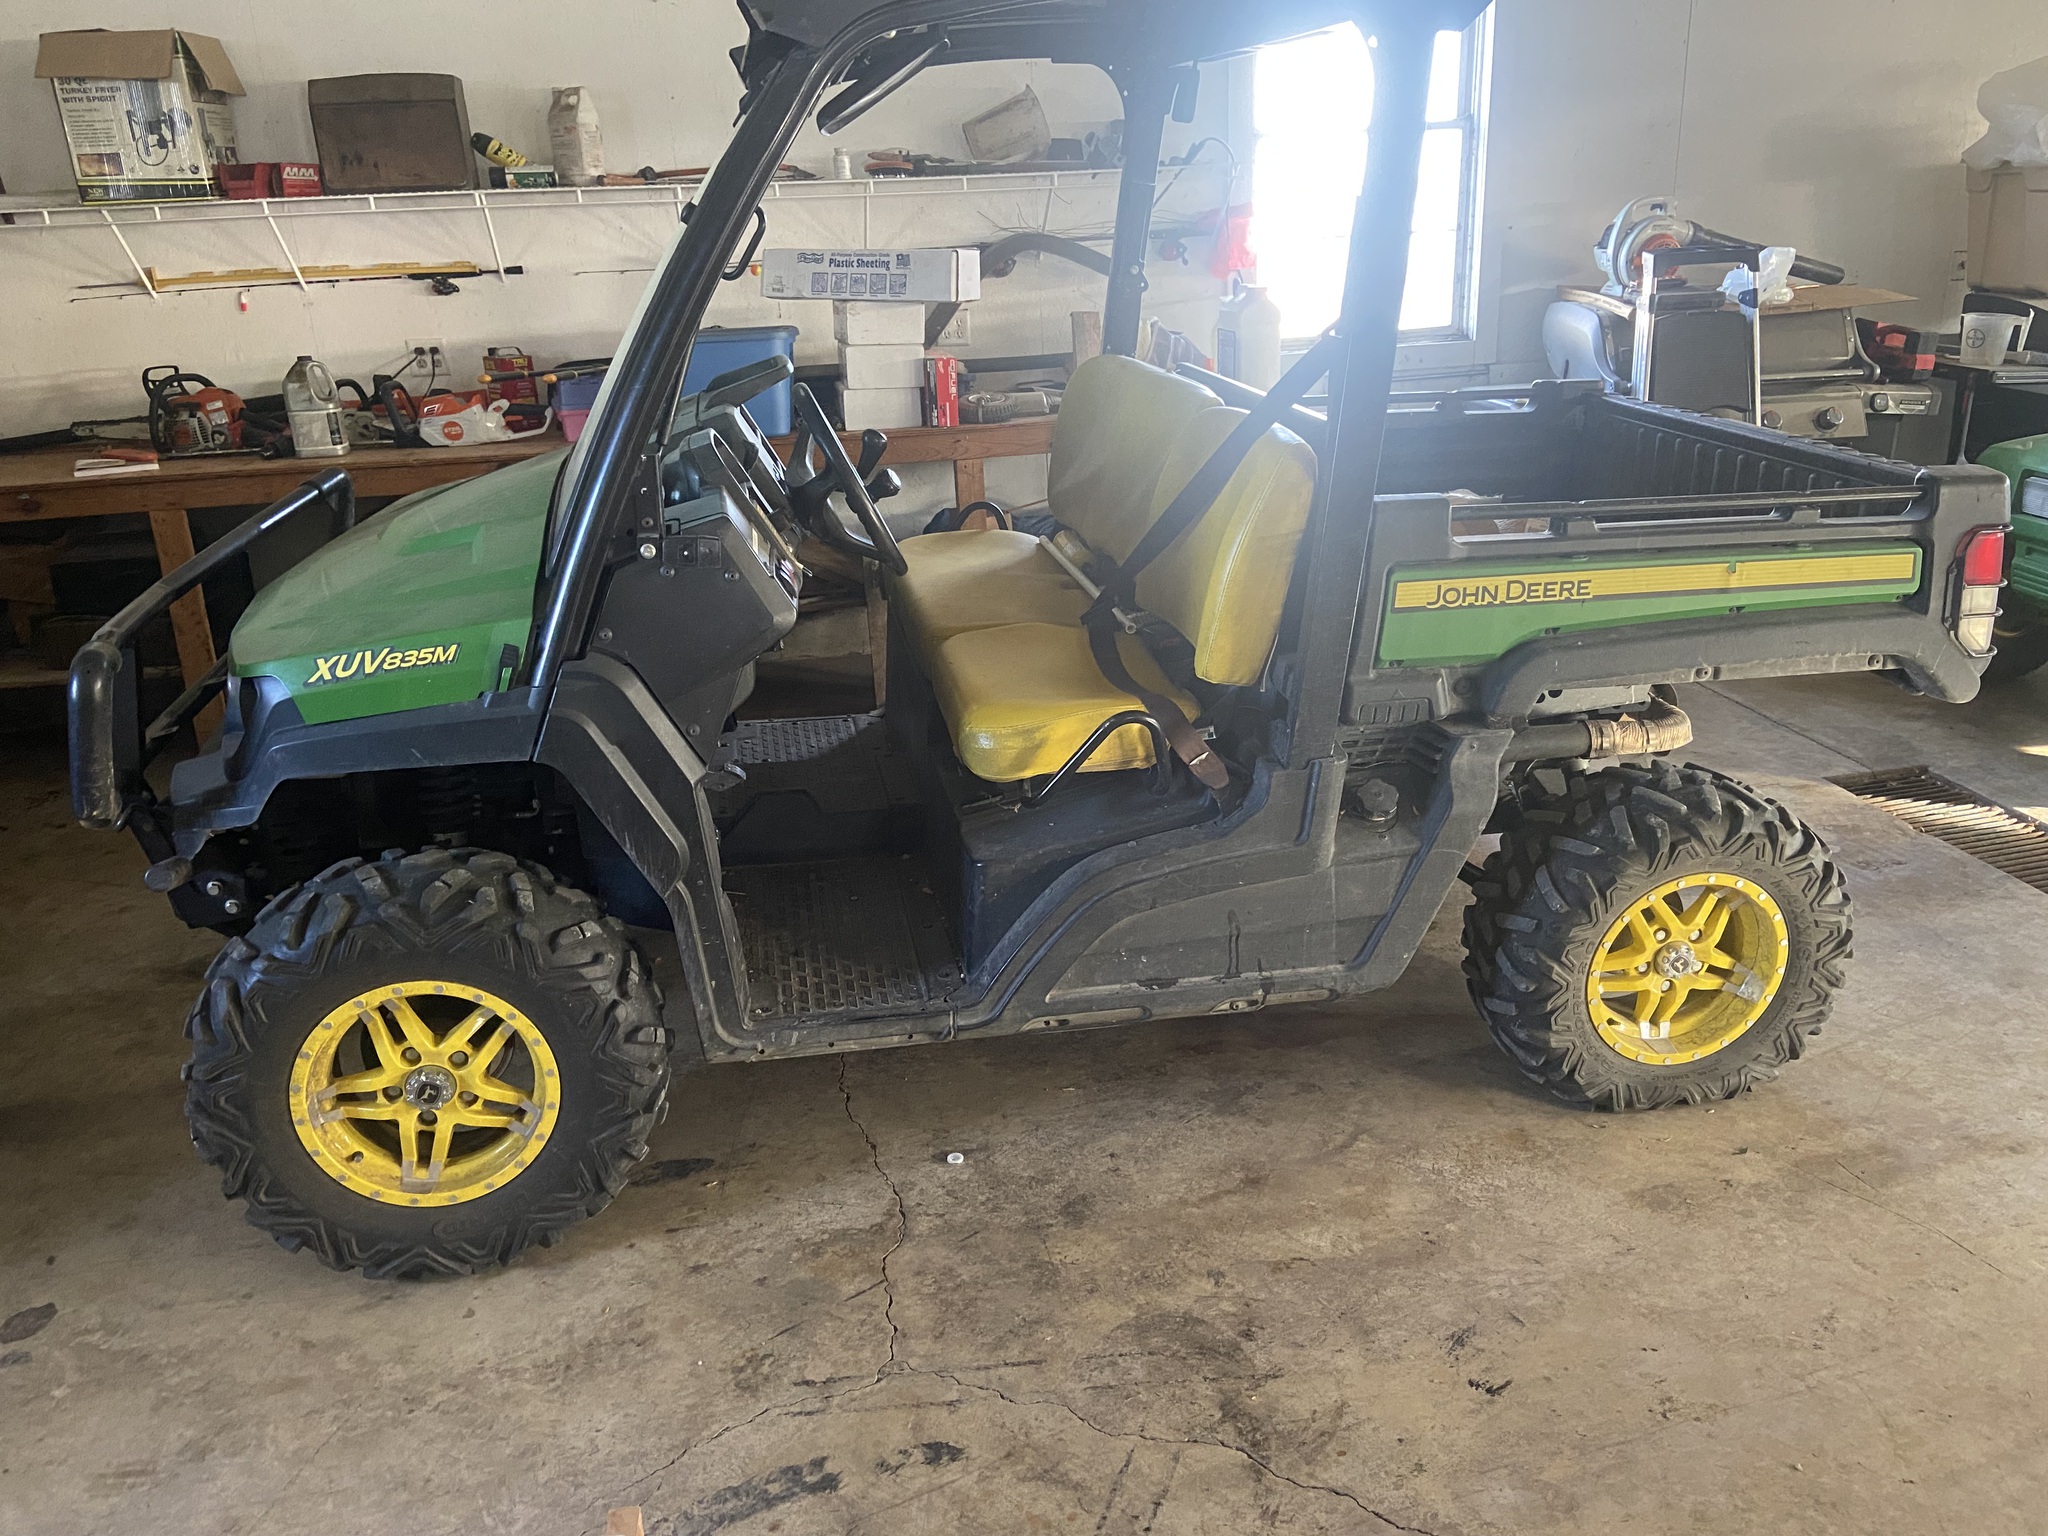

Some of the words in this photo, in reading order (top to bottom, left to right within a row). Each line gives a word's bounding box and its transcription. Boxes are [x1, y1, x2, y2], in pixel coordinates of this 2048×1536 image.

[60, 87, 93, 95] TURKEY
[94, 86, 122, 94] FRYER
[61, 95, 84, 104] WITH
[85, 95, 117, 103] SPIGOT
[828, 258, 854, 268] Plastic
[855, 258, 891, 271] Sheeting
[1426, 584, 1500, 608] JOHN
[1505, 579, 1593, 603] DEERE
[305, 643, 461, 686] XUV835M
